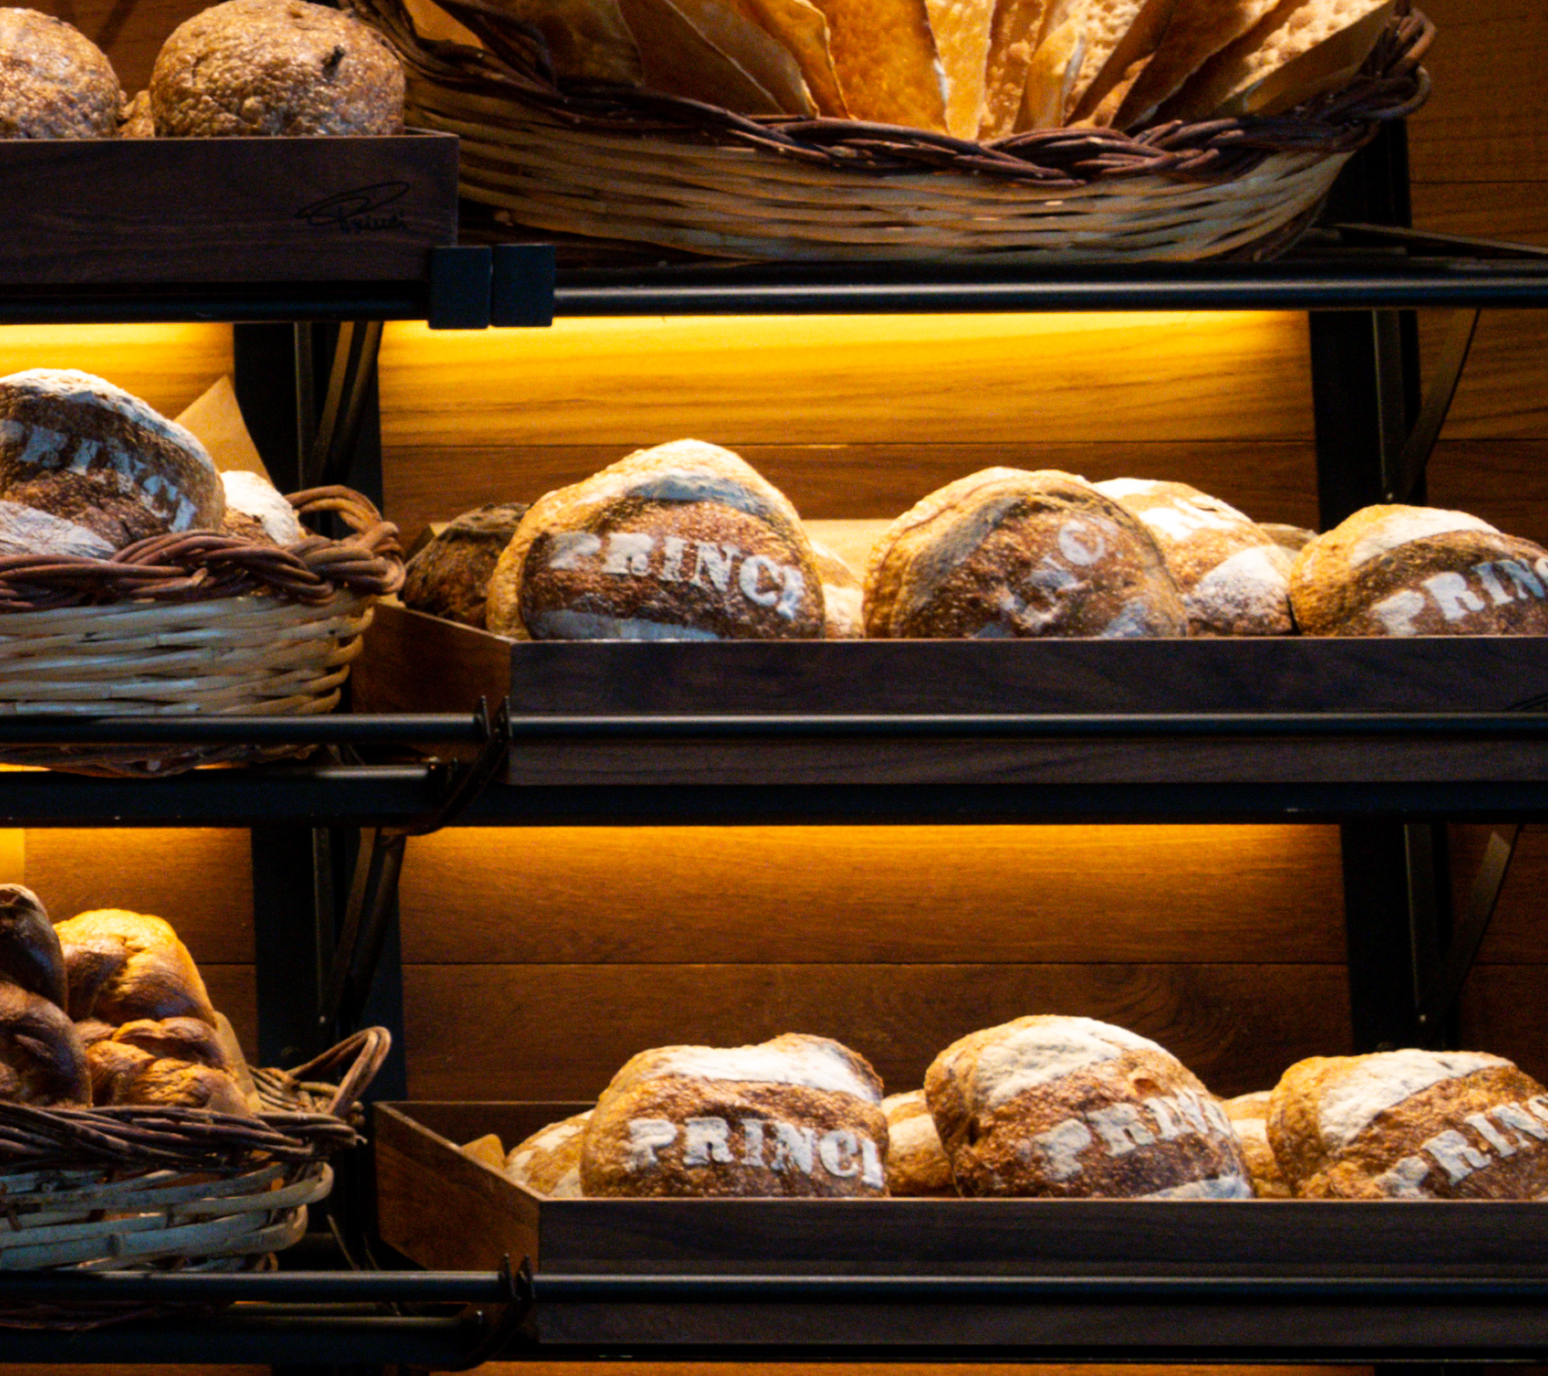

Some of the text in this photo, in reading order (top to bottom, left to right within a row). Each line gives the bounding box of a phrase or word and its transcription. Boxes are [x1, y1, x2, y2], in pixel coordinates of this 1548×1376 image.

[548, 530, 807, 620] PRINCI
[1370, 556, 1548, 636] PRIN
[622, 1115, 885, 1190] PRINCI
